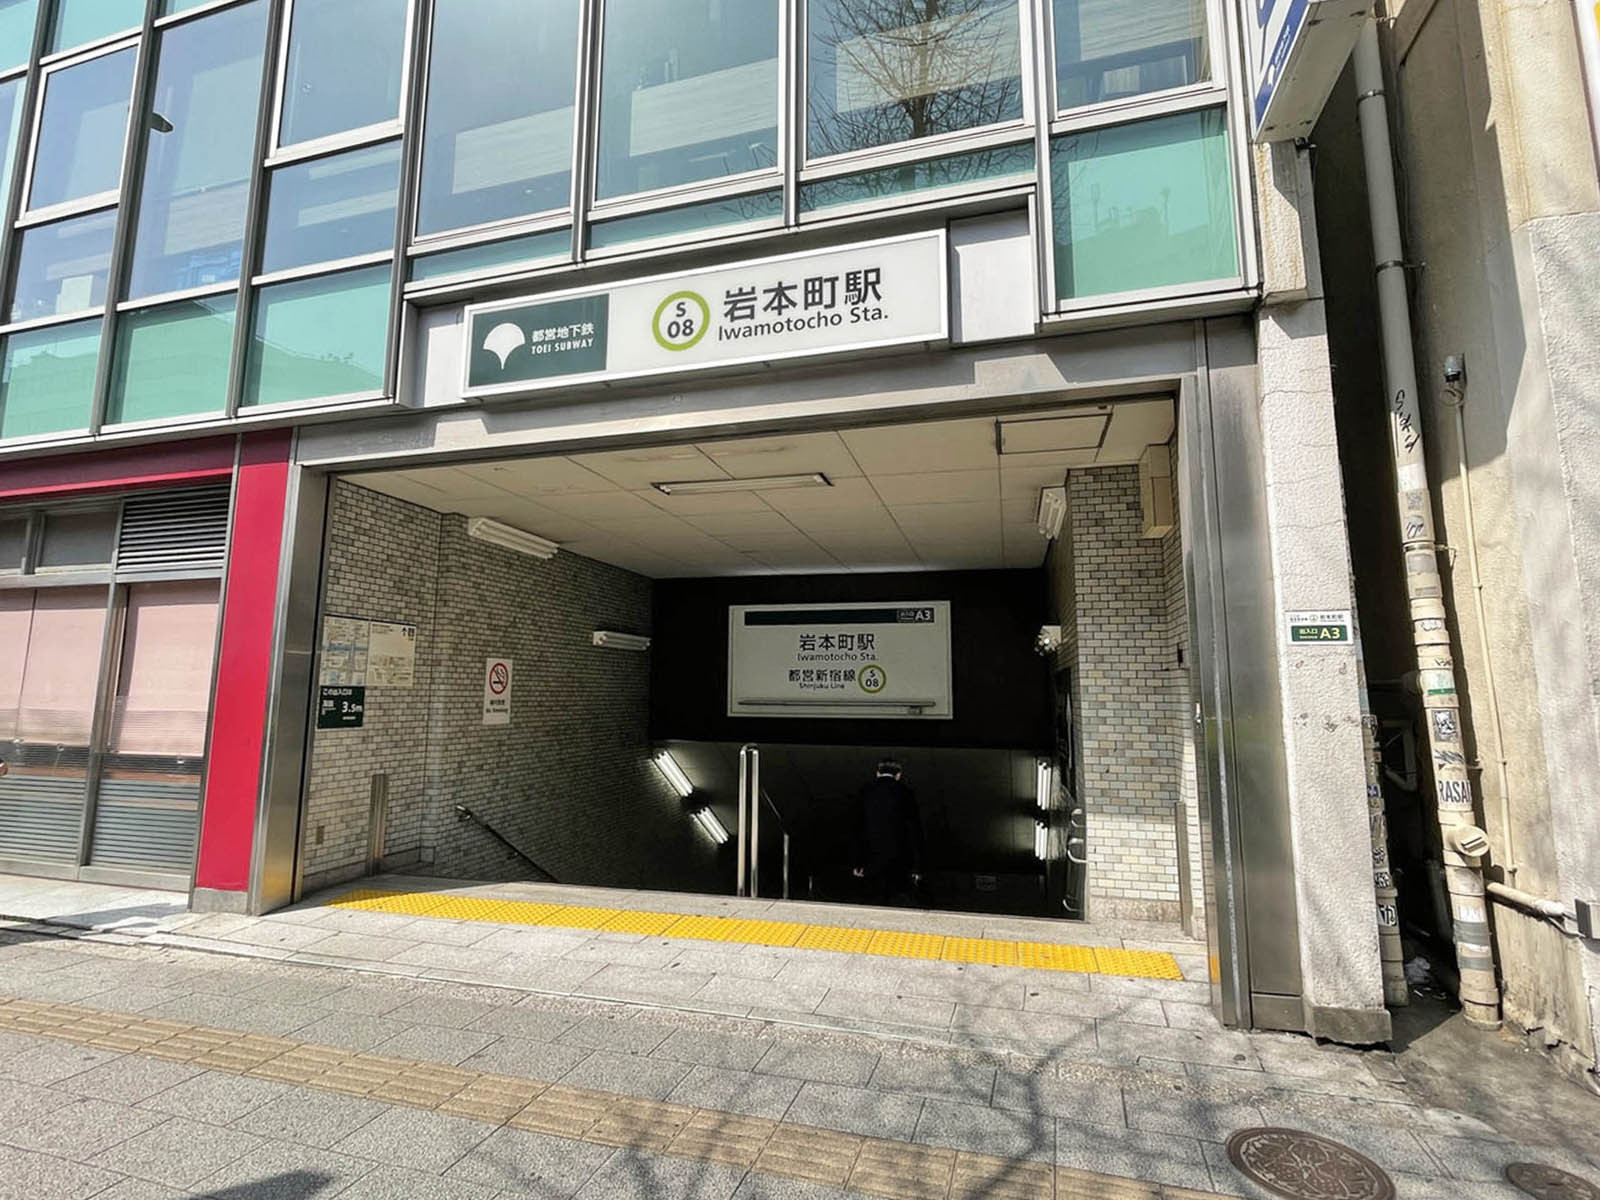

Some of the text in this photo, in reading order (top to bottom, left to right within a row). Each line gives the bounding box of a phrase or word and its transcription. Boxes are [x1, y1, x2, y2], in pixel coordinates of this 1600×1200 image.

[723, 267, 882, 323] 岩本町駅
[675, 301, 687, 318] S
[667, 318, 694, 338] 08
[718, 306, 889, 341] Iwamotocho Sta.
[531, 322, 595, 343] 都営地下鉄
[531, 338, 594, 355] TOEI SUBWAY
[915, 610, 931, 621] A3
[1320, 627, 1341, 639] A3
[799, 633, 875, 651] 岩本町駅
[797, 652, 858, 662] Iwamotocho
[788, 669, 856, 683] 都営新宿線
[869, 669, 876, 678] S
[865, 678, 880, 688] 08
